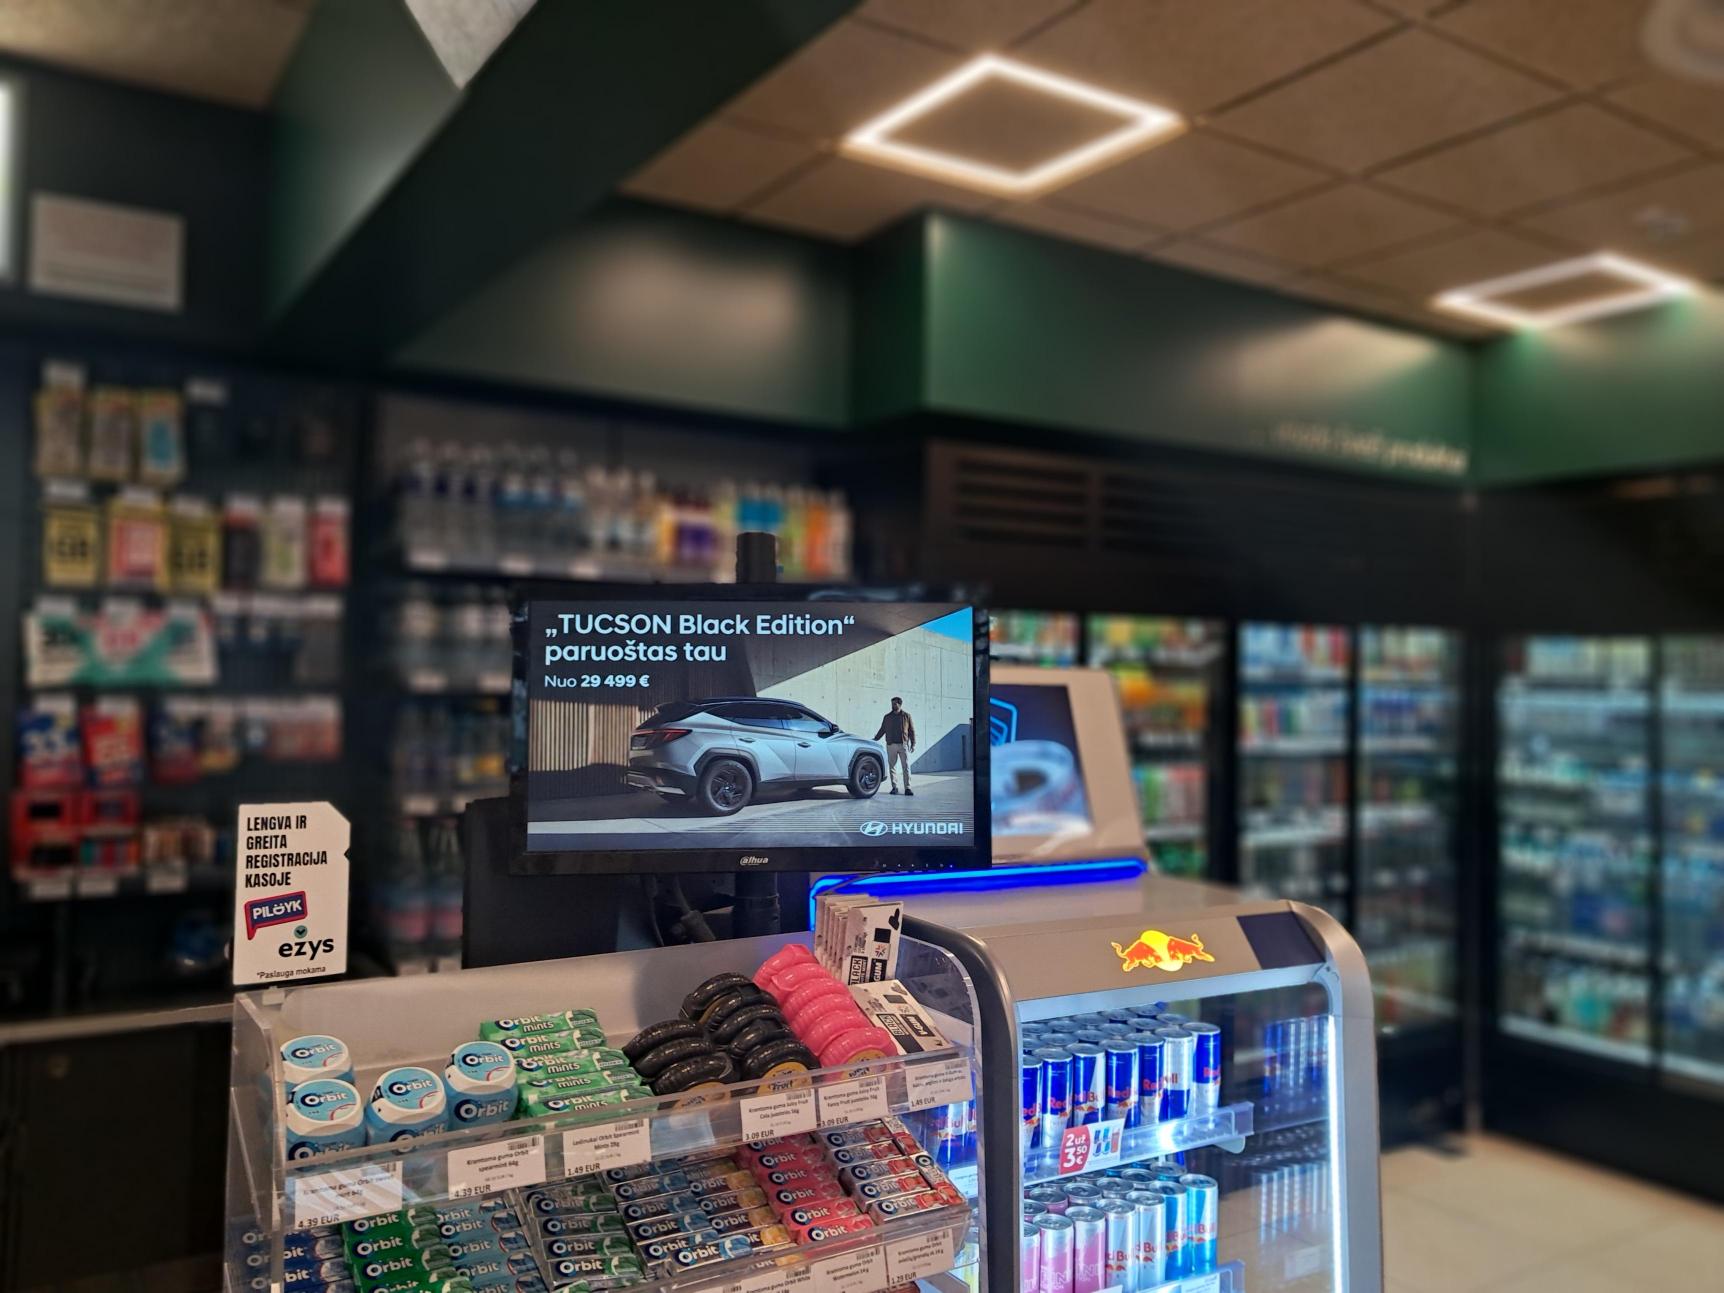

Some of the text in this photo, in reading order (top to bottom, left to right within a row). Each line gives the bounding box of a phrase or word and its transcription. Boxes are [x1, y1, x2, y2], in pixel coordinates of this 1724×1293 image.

[545, 614, 855, 637] „TUCSON Black Edition“
[545, 640, 727, 665] paruoštas tau
[544, 674, 650, 687] Nuo 29 499 €
[247, 815, 307, 831] LENGVA IR
[892, 822, 963, 834] HYUNDAI
[246, 835, 287, 850] GREITA
[246, 851, 327, 869] REGISTRACIJA
[245, 872, 291, 888] KASOJE
[295, 965, 326, 975] mokama
[500, 1015, 541, 1028] Orbit
[523, 1021, 554, 1033] mints
[505, 1035, 548, 1047] Orbit
[529, 1041, 561, 1053] mints
[295, 1042, 336, 1058] Orbit
[465, 1054, 504, 1065] Orbit
[548, 1062, 580, 1074] mints
[392, 1081, 432, 1094] Orbit
[558, 1077, 591, 1089] mints
[305, 1090, 348, 1106] Orbit
[549, 1095, 593, 1107] Orbit
[459, 1100, 509, 1119] Orbit
[836, 1115, 848, 1124] EUR
[760, 1129, 775, 1138] EUR
[1066, 1134, 1075, 1147] 2
[514, 1149, 529, 1157] Orbit
[764, 1151, 797, 1166] Orbit
[1063, 1147, 1076, 1168] 3
[567, 1166, 584, 1176] 1.49
[585, 1162, 601, 1173] EUR
[773, 1170, 808, 1183] Orbit
[454, 1184, 491, 1198] 4.39 EUR
[690, 1176, 726, 1192] Orbit
[864, 1181, 898, 1195] Orbit
[780, 1188, 815, 1202] Orbit
[628, 1201, 668, 1217] Orbit
[701, 1195, 737, 1211] Orbit
[881, 1198, 916, 1212] Orbit
[320, 1213, 340, 1225] EUR
[712, 1213, 749, 1230] Orbit
[795, 1207, 830, 1222] Orbit
[354, 1213, 399, 1232] Orbit
[441, 1220, 482, 1236] Orbit
[547, 1219, 591, 1233] Orbit
[638, 1220, 678, 1237] Orbit
[811, 1224, 847, 1242] Orbit
[357, 1236, 403, 1255] Orbit
[451, 1241, 491, 1257] Orbit
[552, 1239, 595, 1254] Orbit
[649, 1238, 689, 1257] Orbit
[678, 1246, 719, 1263] Orbit
[366, 1257, 413, 1277] Orbit
[559, 1259, 603, 1274] Orbit
[905, 1272, 917, 1281] EUR
